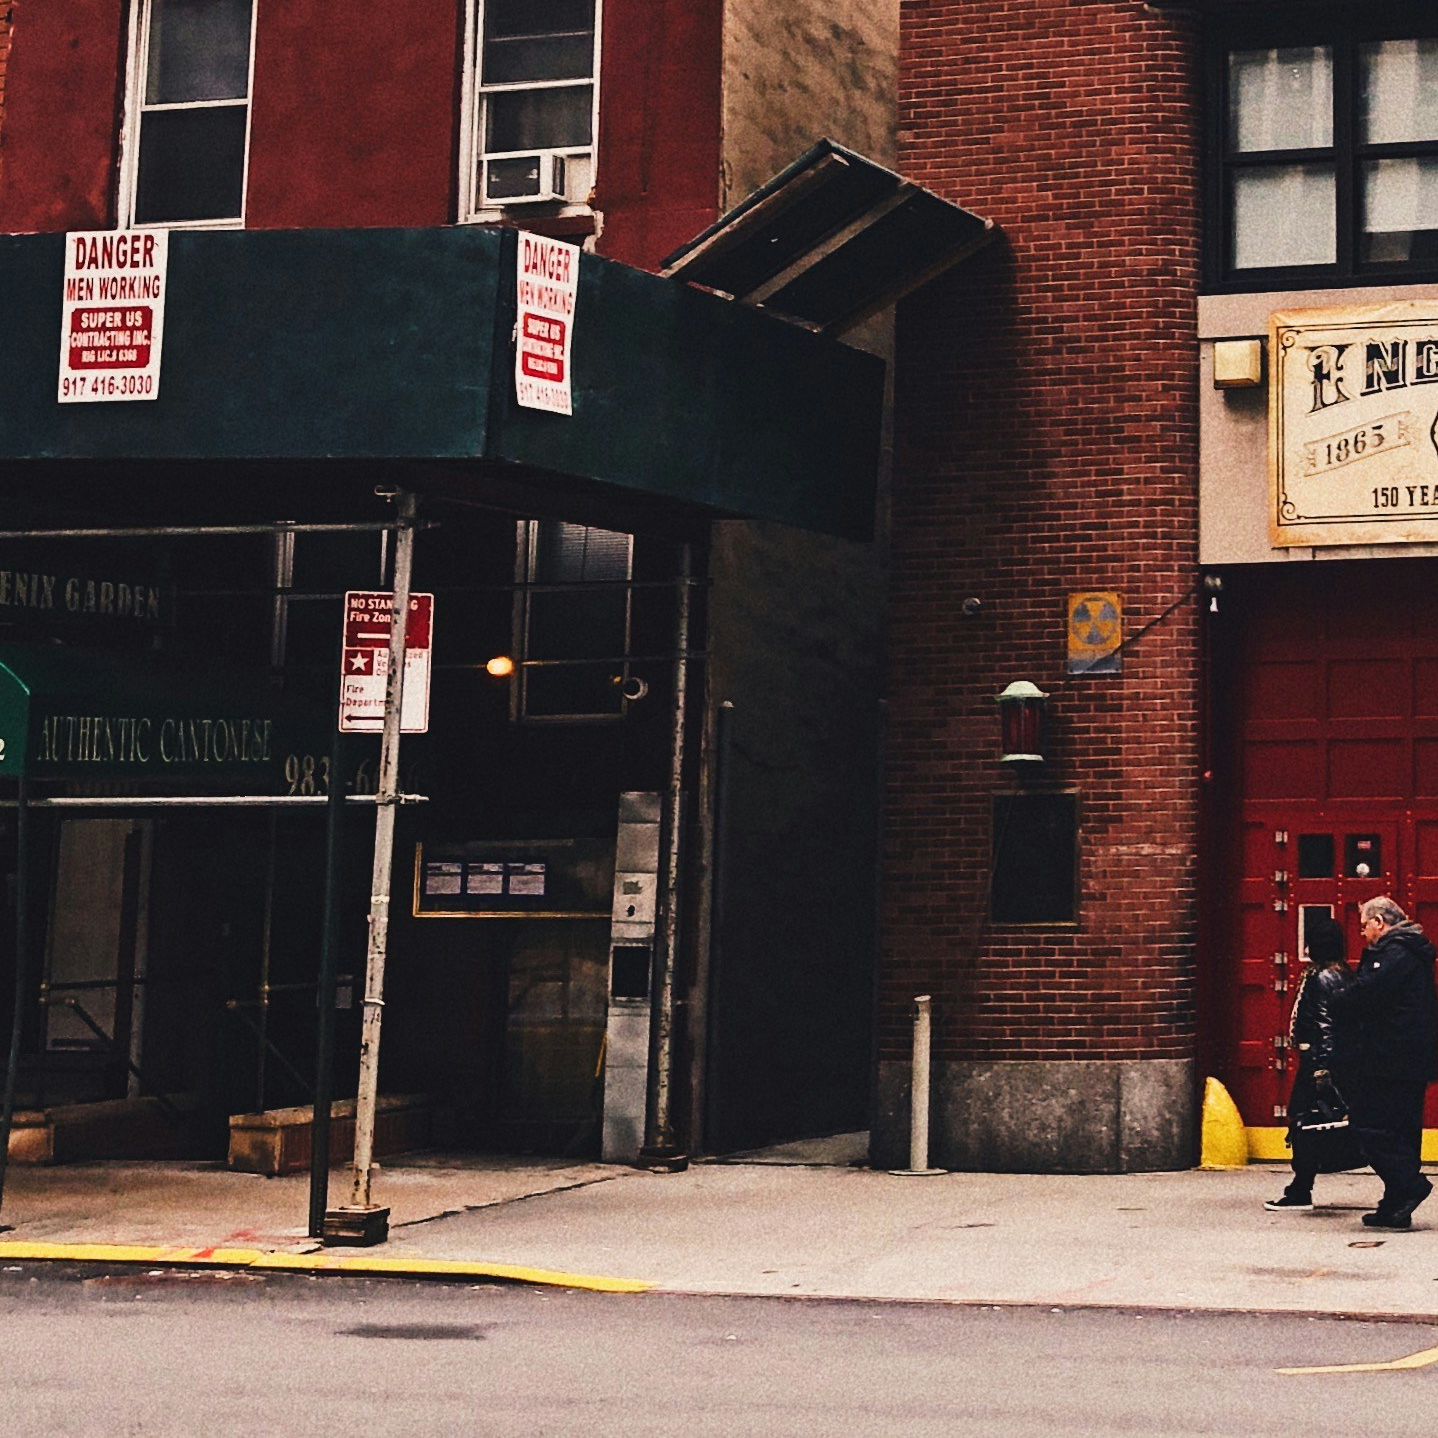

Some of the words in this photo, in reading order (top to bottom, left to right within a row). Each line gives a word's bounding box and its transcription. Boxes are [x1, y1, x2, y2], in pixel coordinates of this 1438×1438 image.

[75, 234, 155, 271] DANGER
[524, 238, 571, 283] DANGER
[66, 277, 94, 302] MEN
[98, 274, 161, 301] WORKING
[81, 311, 122, 328] SUPER
[125, 310, 143, 327] US
[70, 330, 131, 348] CONTRACTING
[132, 329, 151, 346] INC.
[63, 376, 87, 397] 917
[91, 374, 153, 396] 416-3030
[1325, 423, 1386, 466] 1865
[1372, 486, 1400, 509] 150
[64, 576, 161, 619] GARDEN
[350, 598, 366, 610] NO
[368, 598, 419, 611] STANG
[349, 611, 371, 622] Fire
[372, 611, 392, 623] Zon
[346, 684, 365, 694] Fire
[37, 713, 152, 763] AUTHENTIC
[159, 717, 274, 764] CANTONESE
